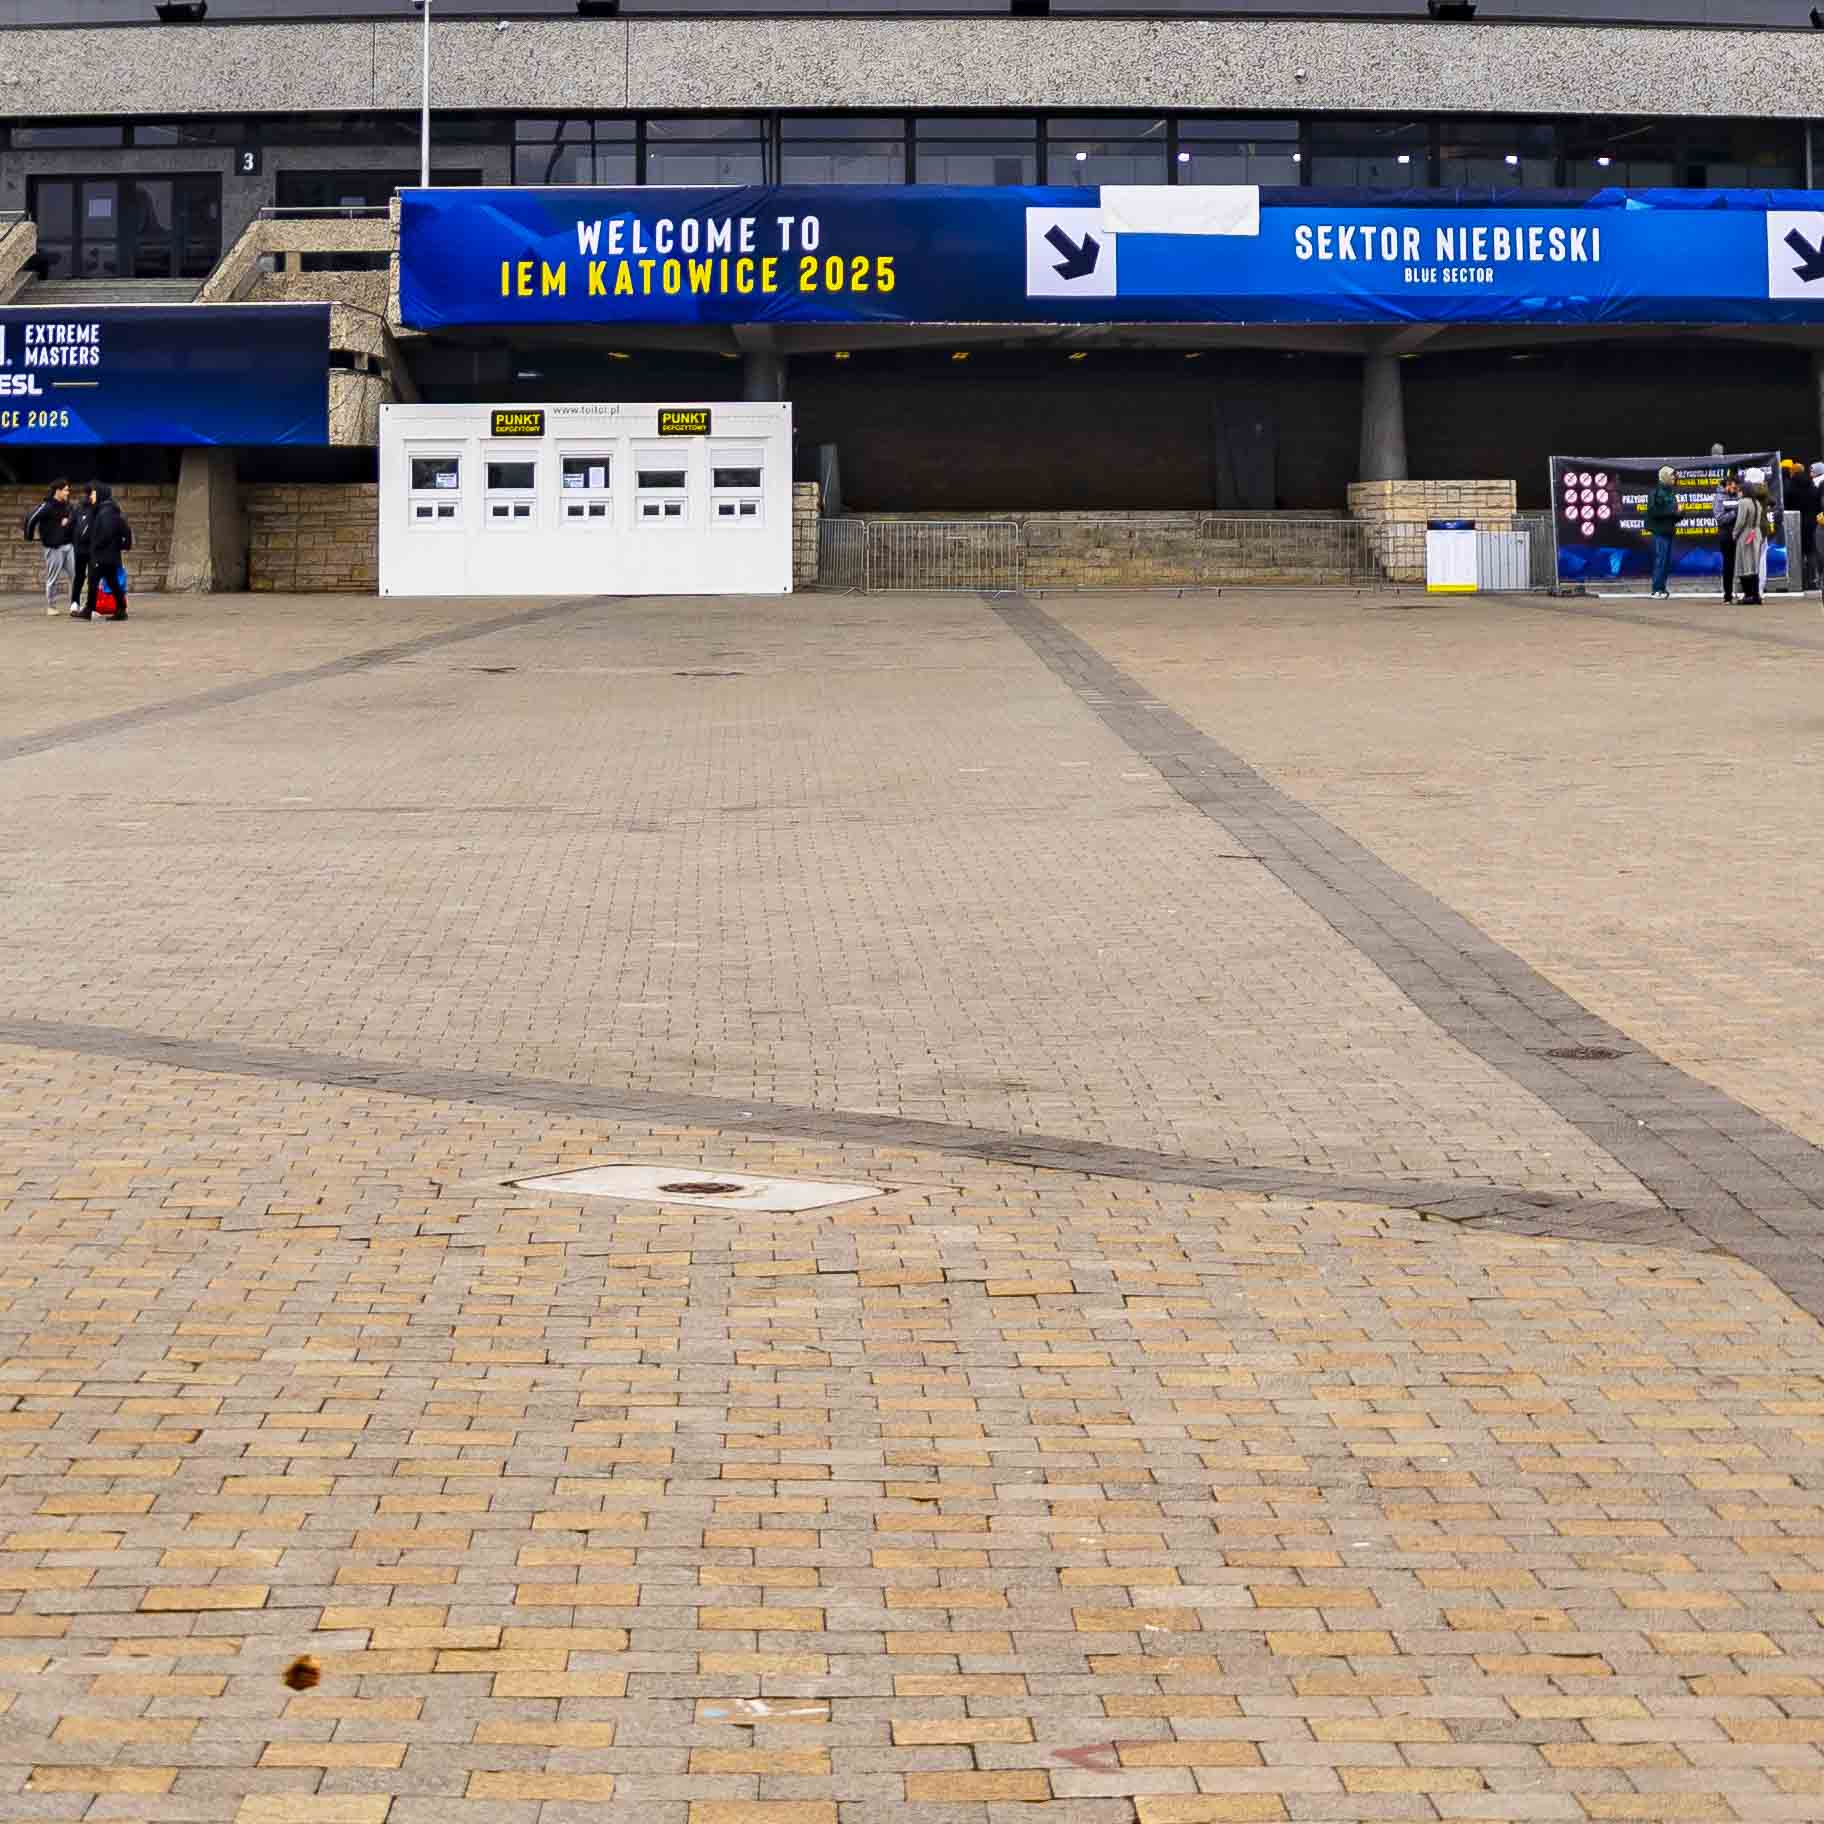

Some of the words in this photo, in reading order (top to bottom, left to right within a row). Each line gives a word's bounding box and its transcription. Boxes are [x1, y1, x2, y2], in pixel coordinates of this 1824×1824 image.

[243, 153, 255, 170] 3
[576, 217, 757, 256] WELCOME
[777, 215, 821, 252] TO
[1294, 224, 1422, 261] SEKTOR
[1436, 226, 1601, 263] NIEBIESKI
[501, 260, 567, 297] IEM
[588, 257, 779, 296] KATOWICE
[799, 255, 896, 293] 2025
[1404, 266, 1438, 283] BLUE
[1442, 266, 1495, 283] SECTOR
[24, 323, 102, 345] EXTREME
[24, 345, 102, 368] MASTERS
[27, 409, 70, 428] 2025
[495, 414, 541, 425] PUNKT
[662, 412, 708, 424] PUNKT
